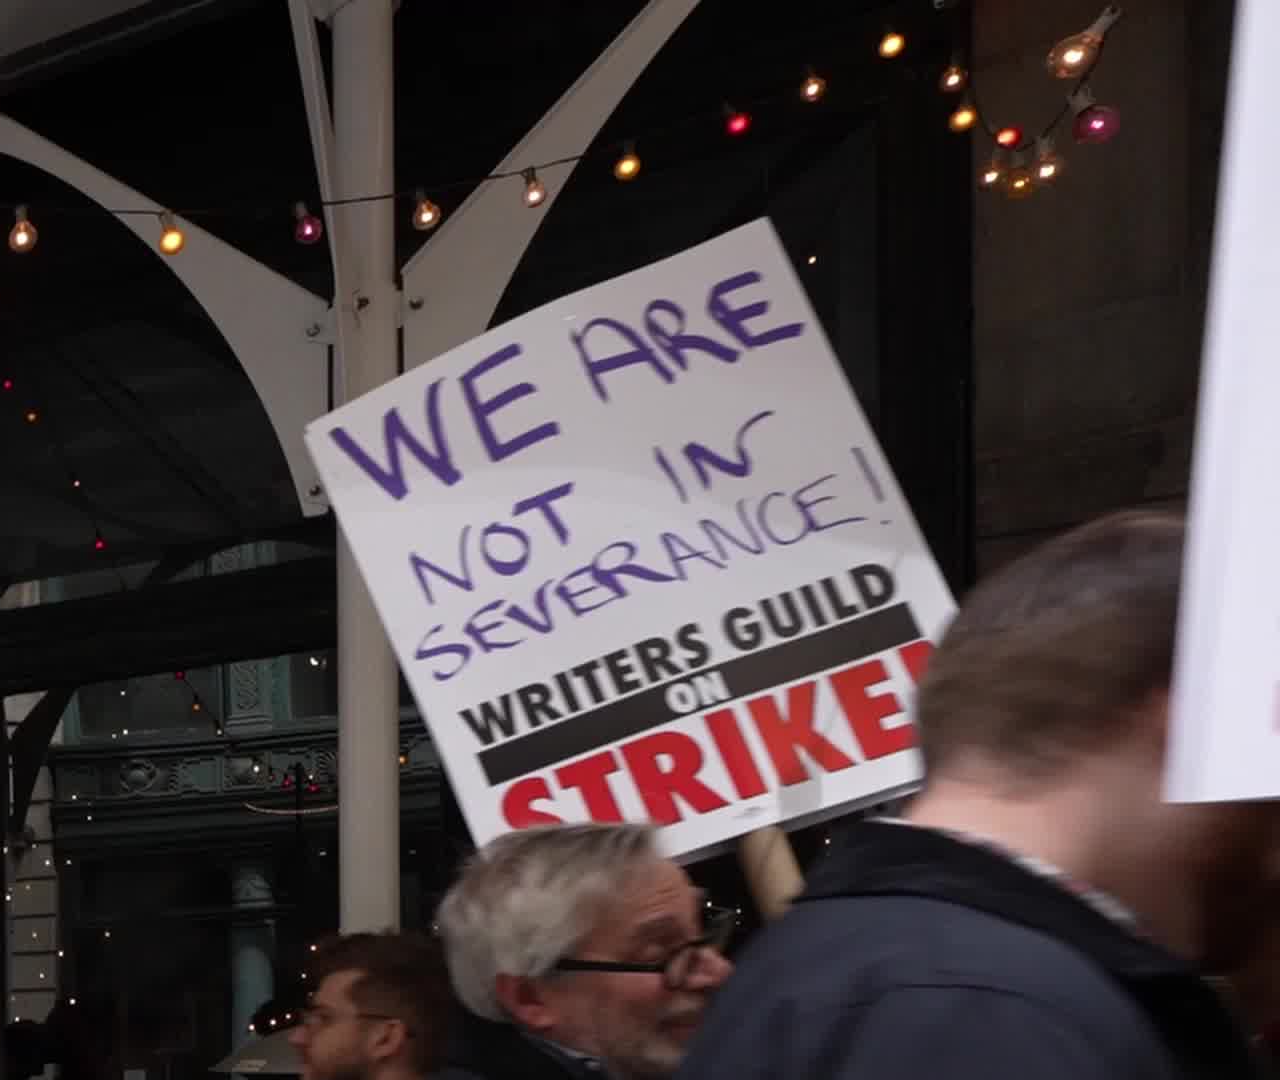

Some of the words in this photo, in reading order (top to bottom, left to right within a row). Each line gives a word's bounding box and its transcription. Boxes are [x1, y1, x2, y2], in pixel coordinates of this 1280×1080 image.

[329, 342, 560, 501] WE
[571, 270, 805, 403] ARE
[409, 481, 574, 605] NOT
[653, 409, 775, 503] IN
[413, 446, 891, 682] SEVERANCE!
[458, 622, 712, 747] WRITERS
[722, 561, 896, 652] GUILD
[664, 669, 732, 715] ON
